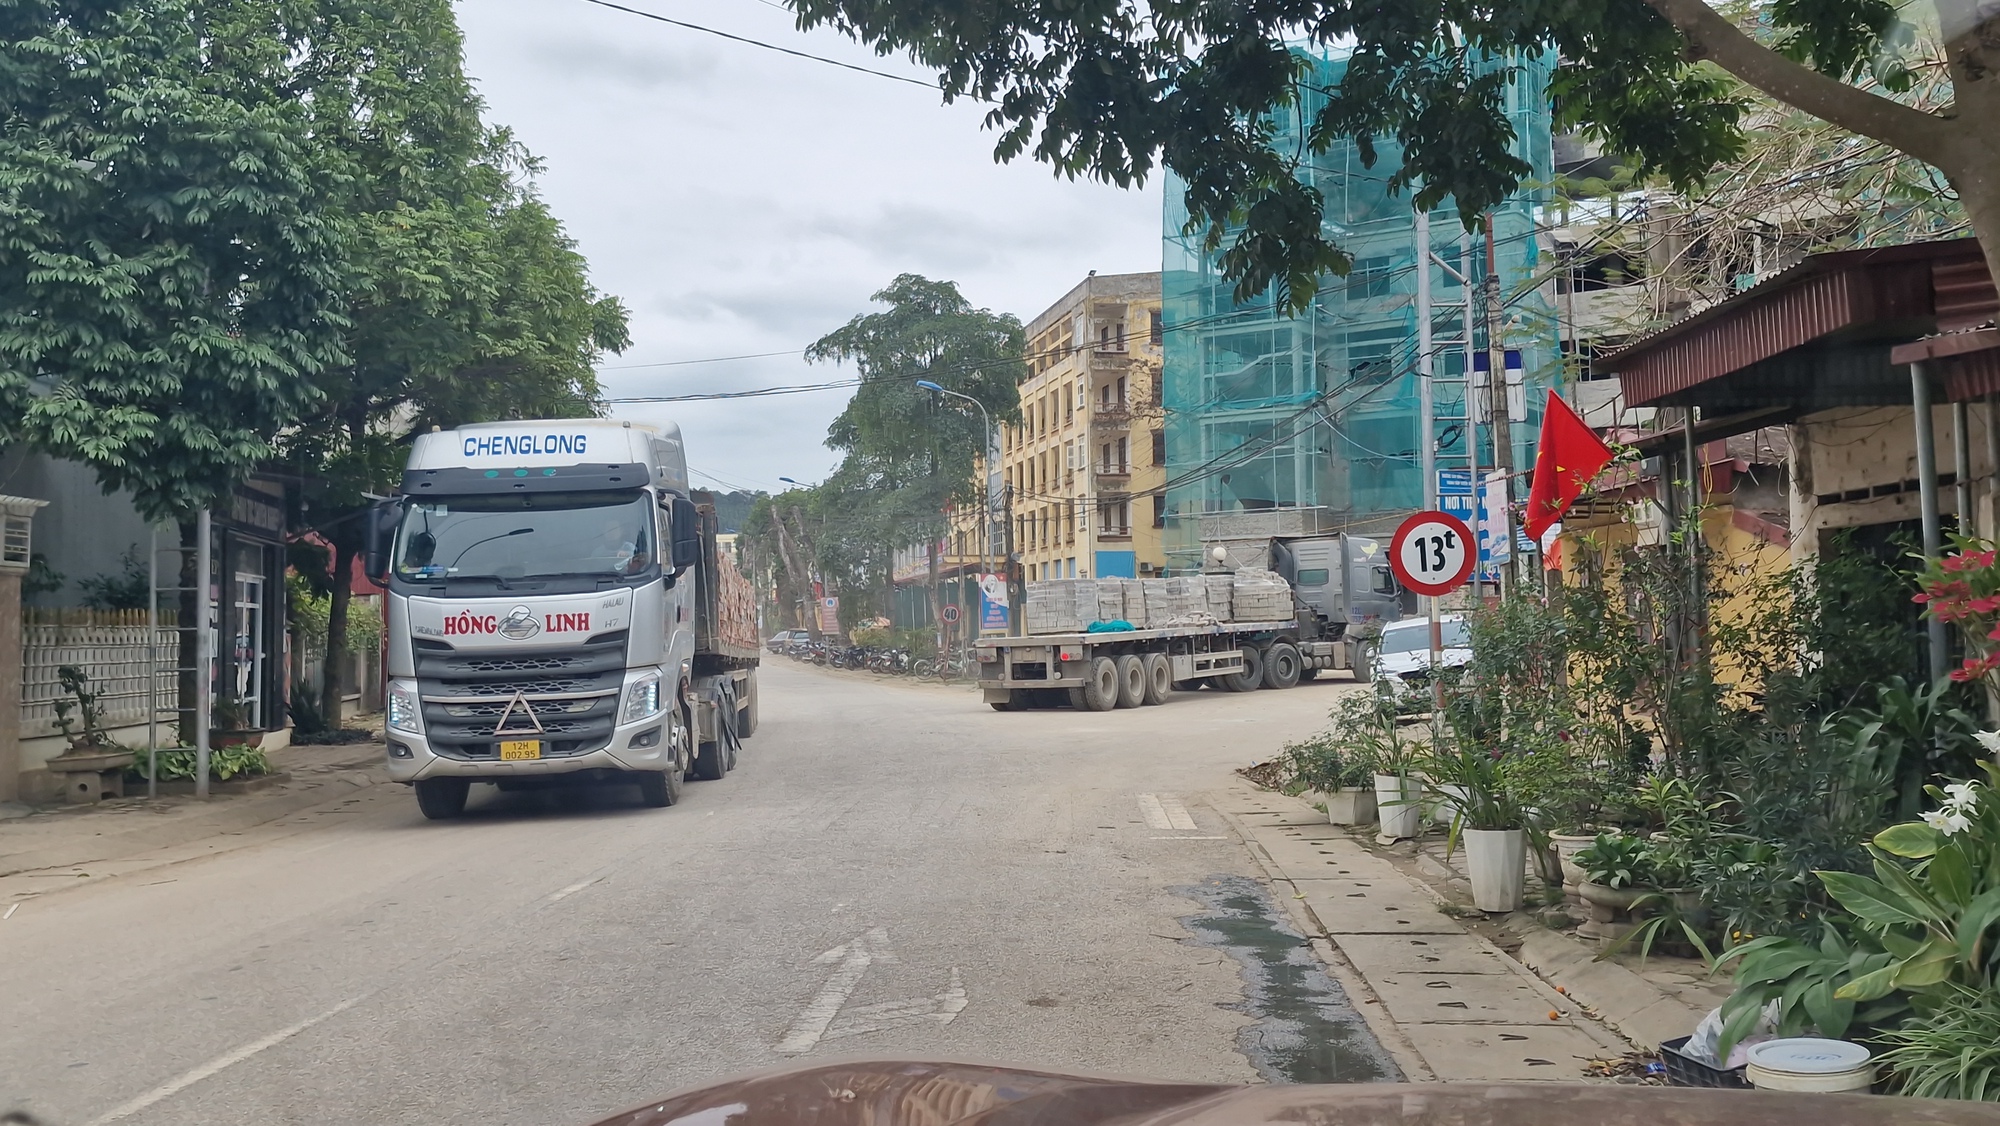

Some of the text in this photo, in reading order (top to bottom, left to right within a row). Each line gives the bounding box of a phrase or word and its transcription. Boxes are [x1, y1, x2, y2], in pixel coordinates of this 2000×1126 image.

[464, 434, 587, 457] CHENGLONG
[1414, 530, 1456, 573] 13t
[443, 608, 590, 635] HỒNG LINH
[944, 608, 957, 620] 40
[512, 741, 529, 751] 12H
